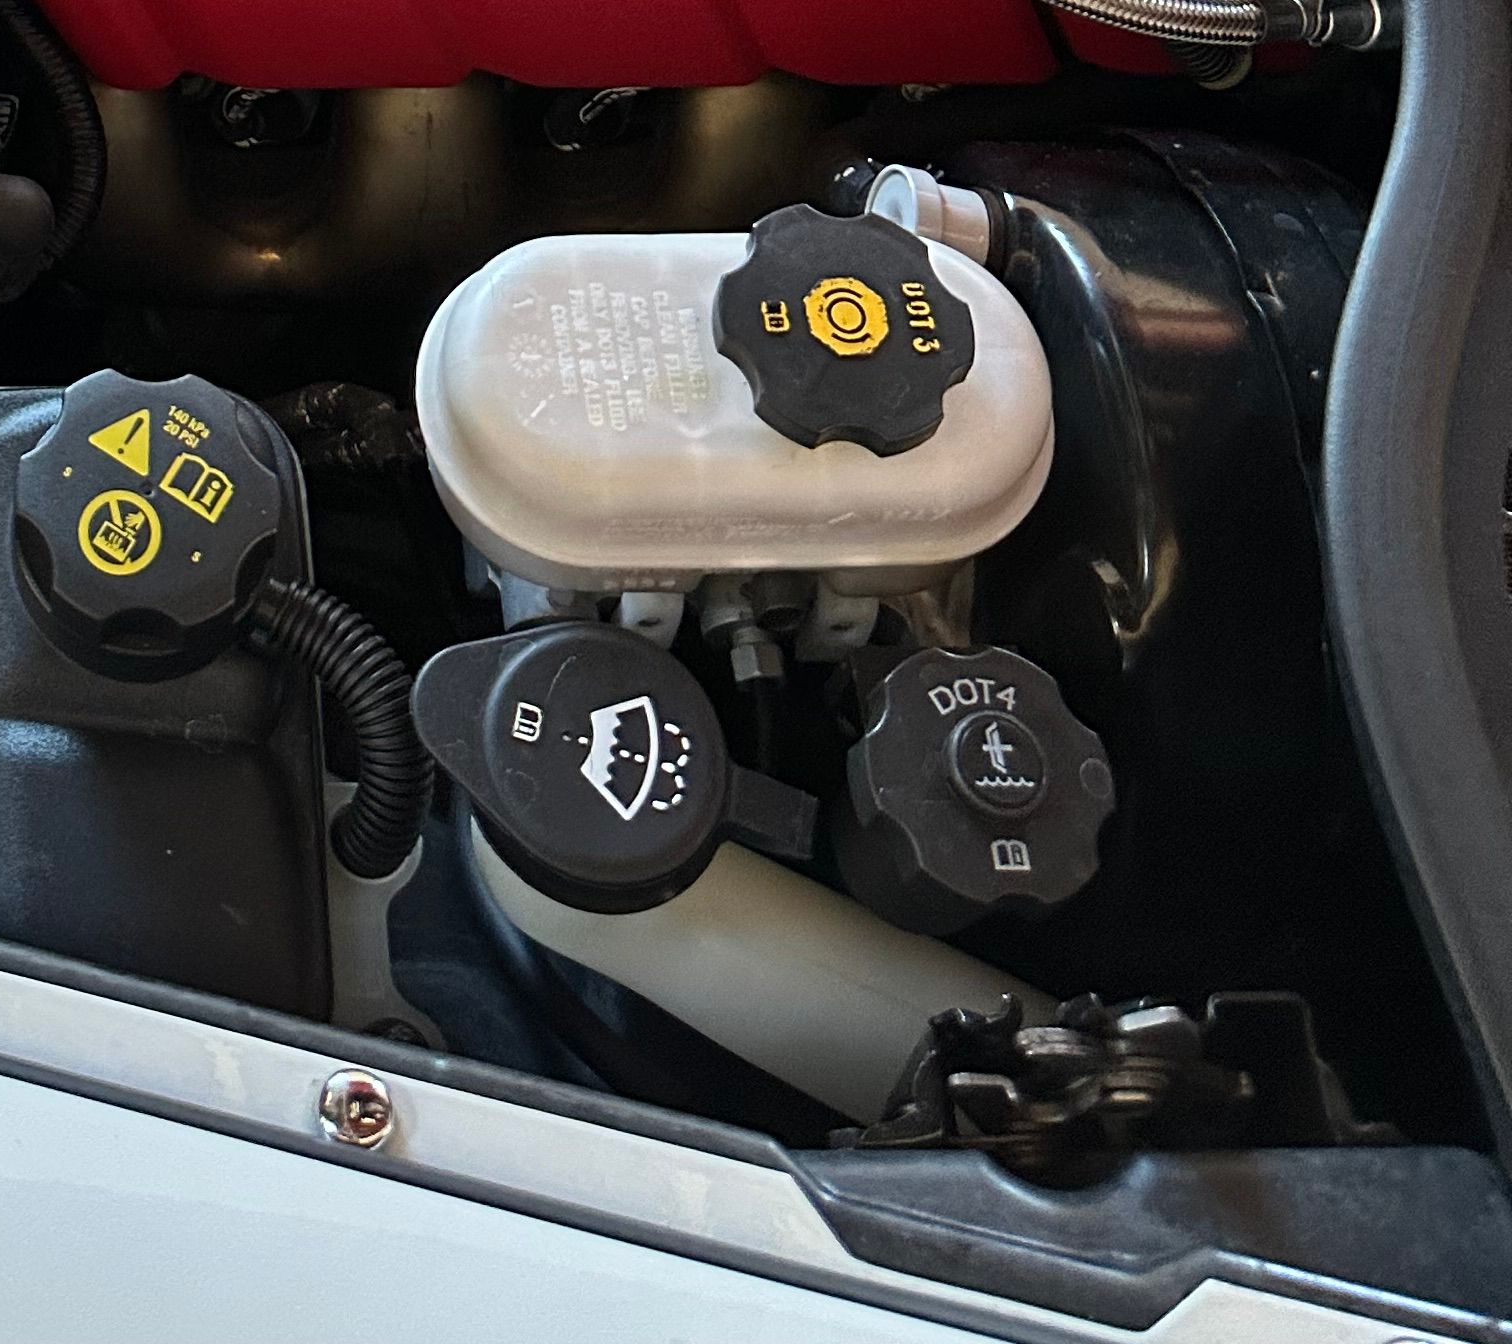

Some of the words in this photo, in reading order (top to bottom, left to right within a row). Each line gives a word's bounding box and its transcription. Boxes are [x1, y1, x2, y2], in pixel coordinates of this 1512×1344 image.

[901, 282, 936, 329] DOT
[912, 337, 941, 352] 3
[168, 405, 189, 423] 140
[163, 420, 180, 436] 20
